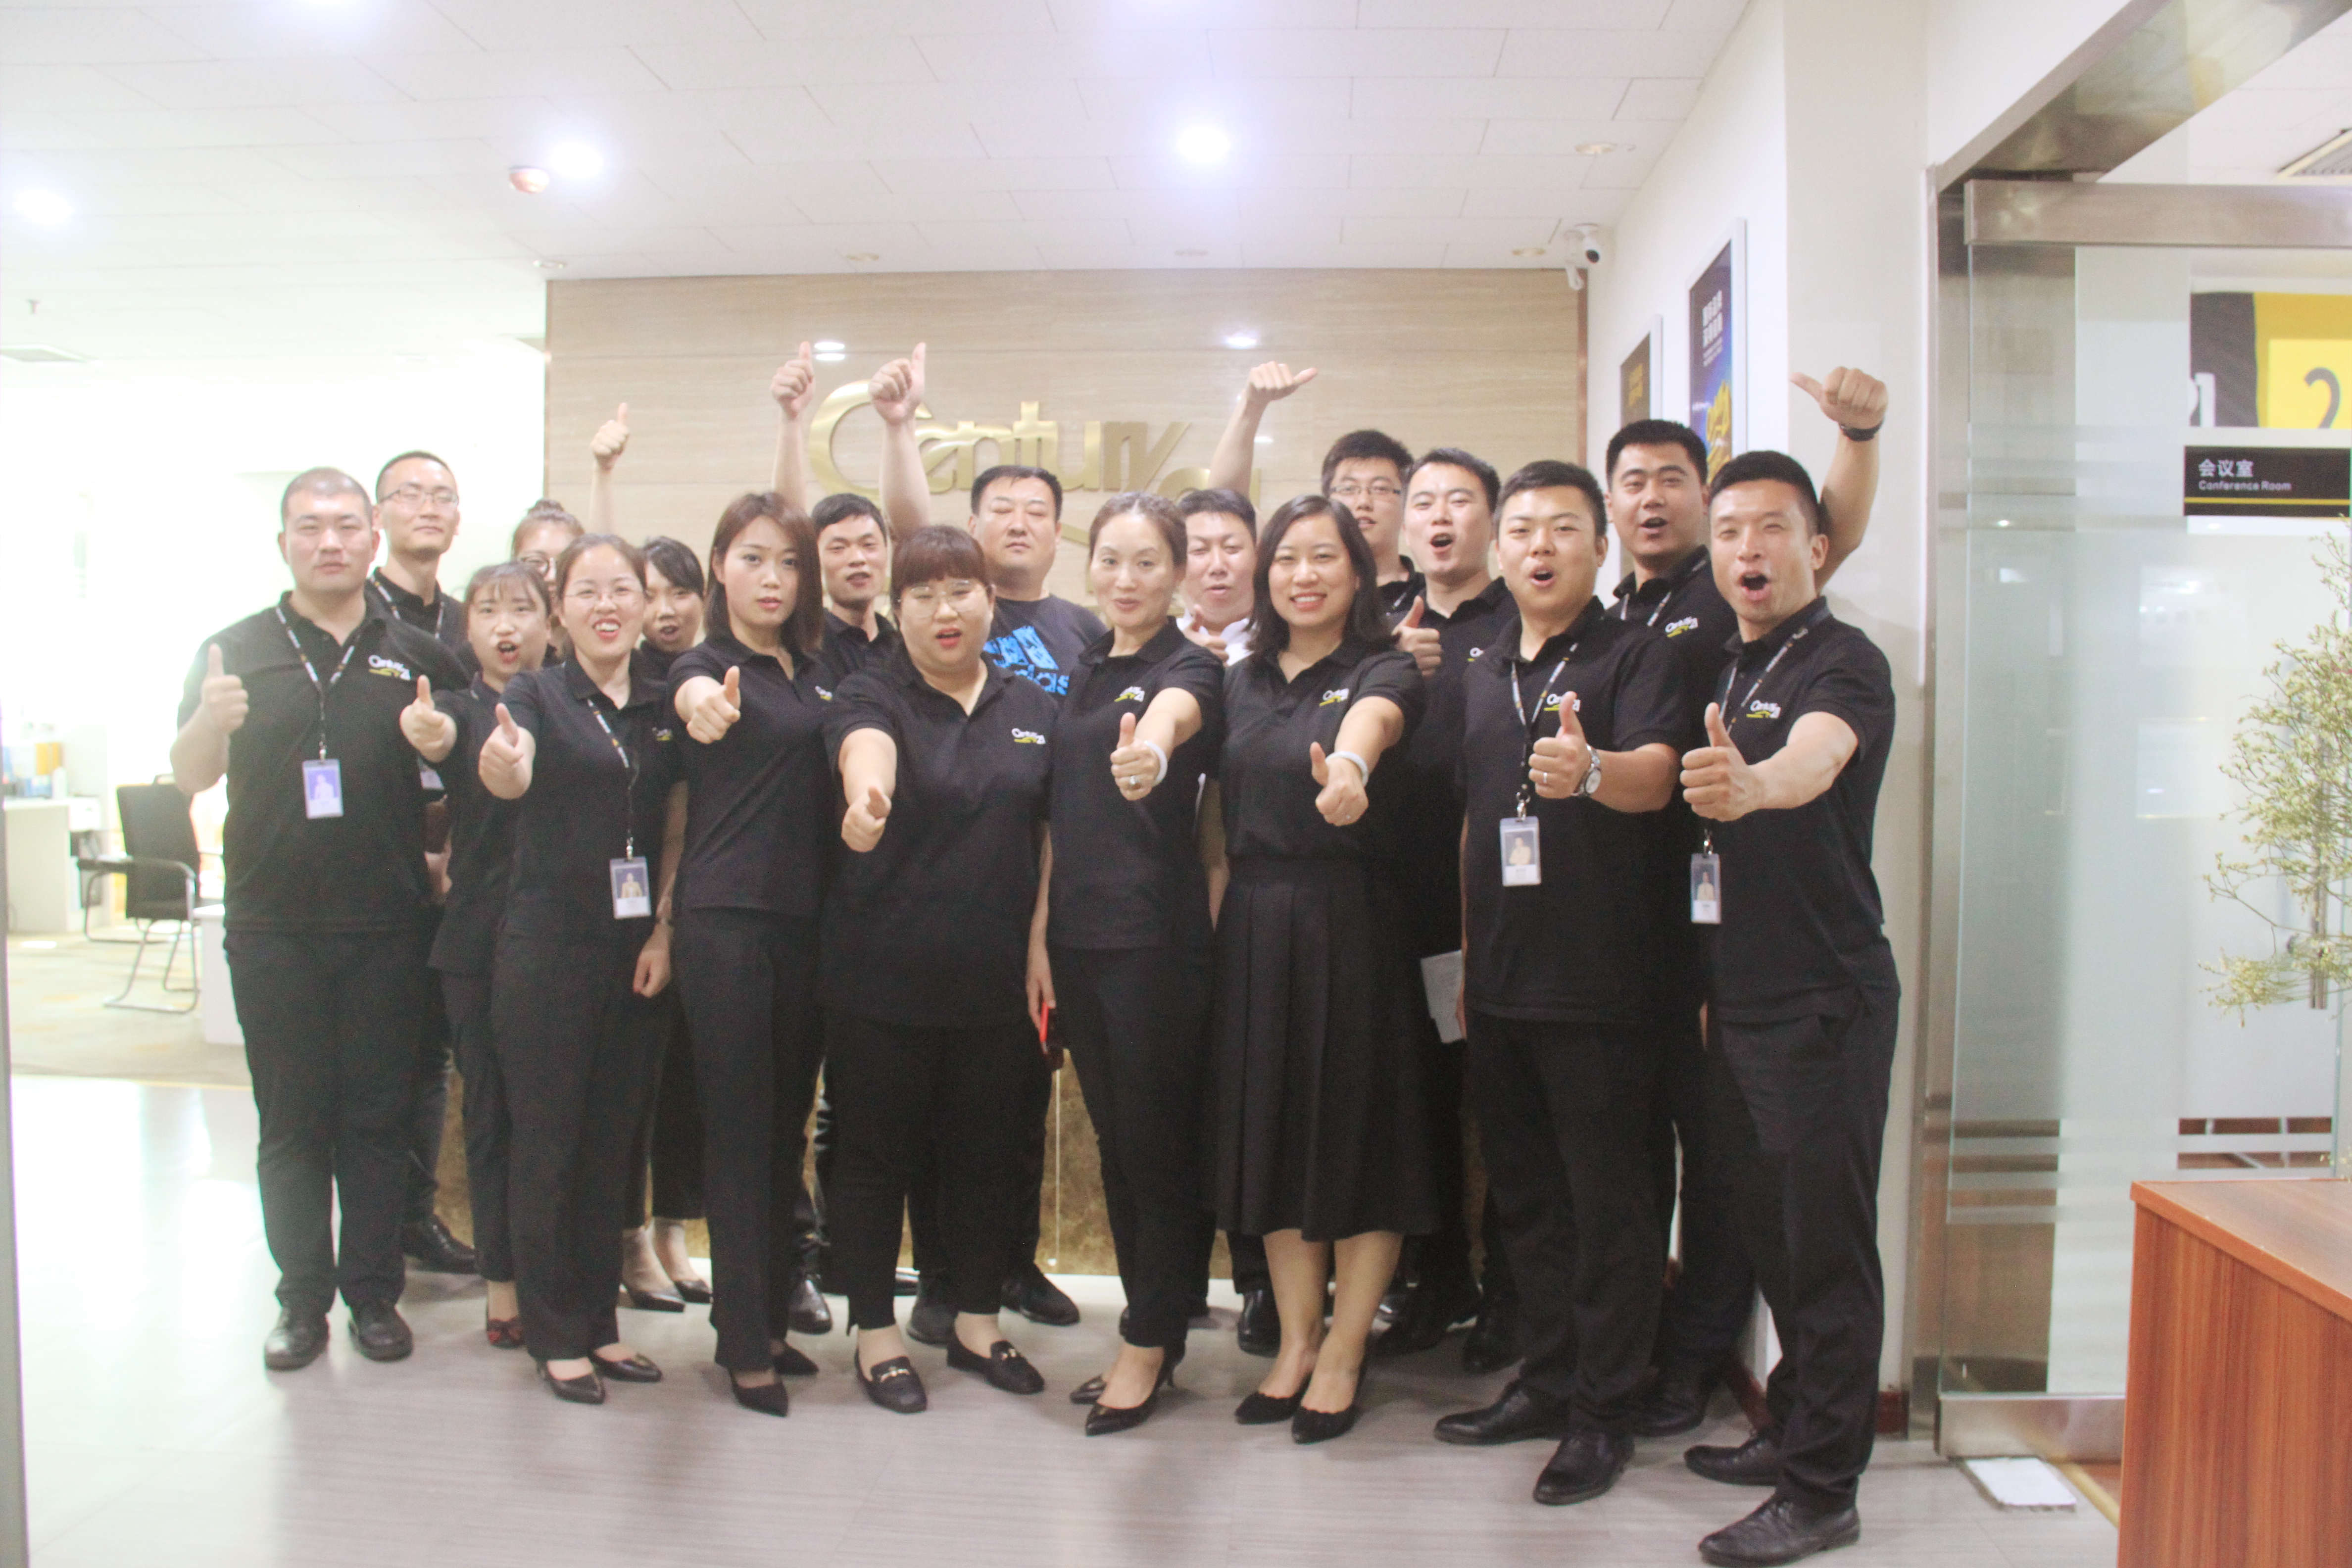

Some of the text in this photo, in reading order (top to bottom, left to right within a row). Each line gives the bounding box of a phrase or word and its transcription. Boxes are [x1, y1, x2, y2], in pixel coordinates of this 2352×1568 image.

[2198, 458, 2254, 478] 会议室
[2261, 480, 2292, 491] Room
